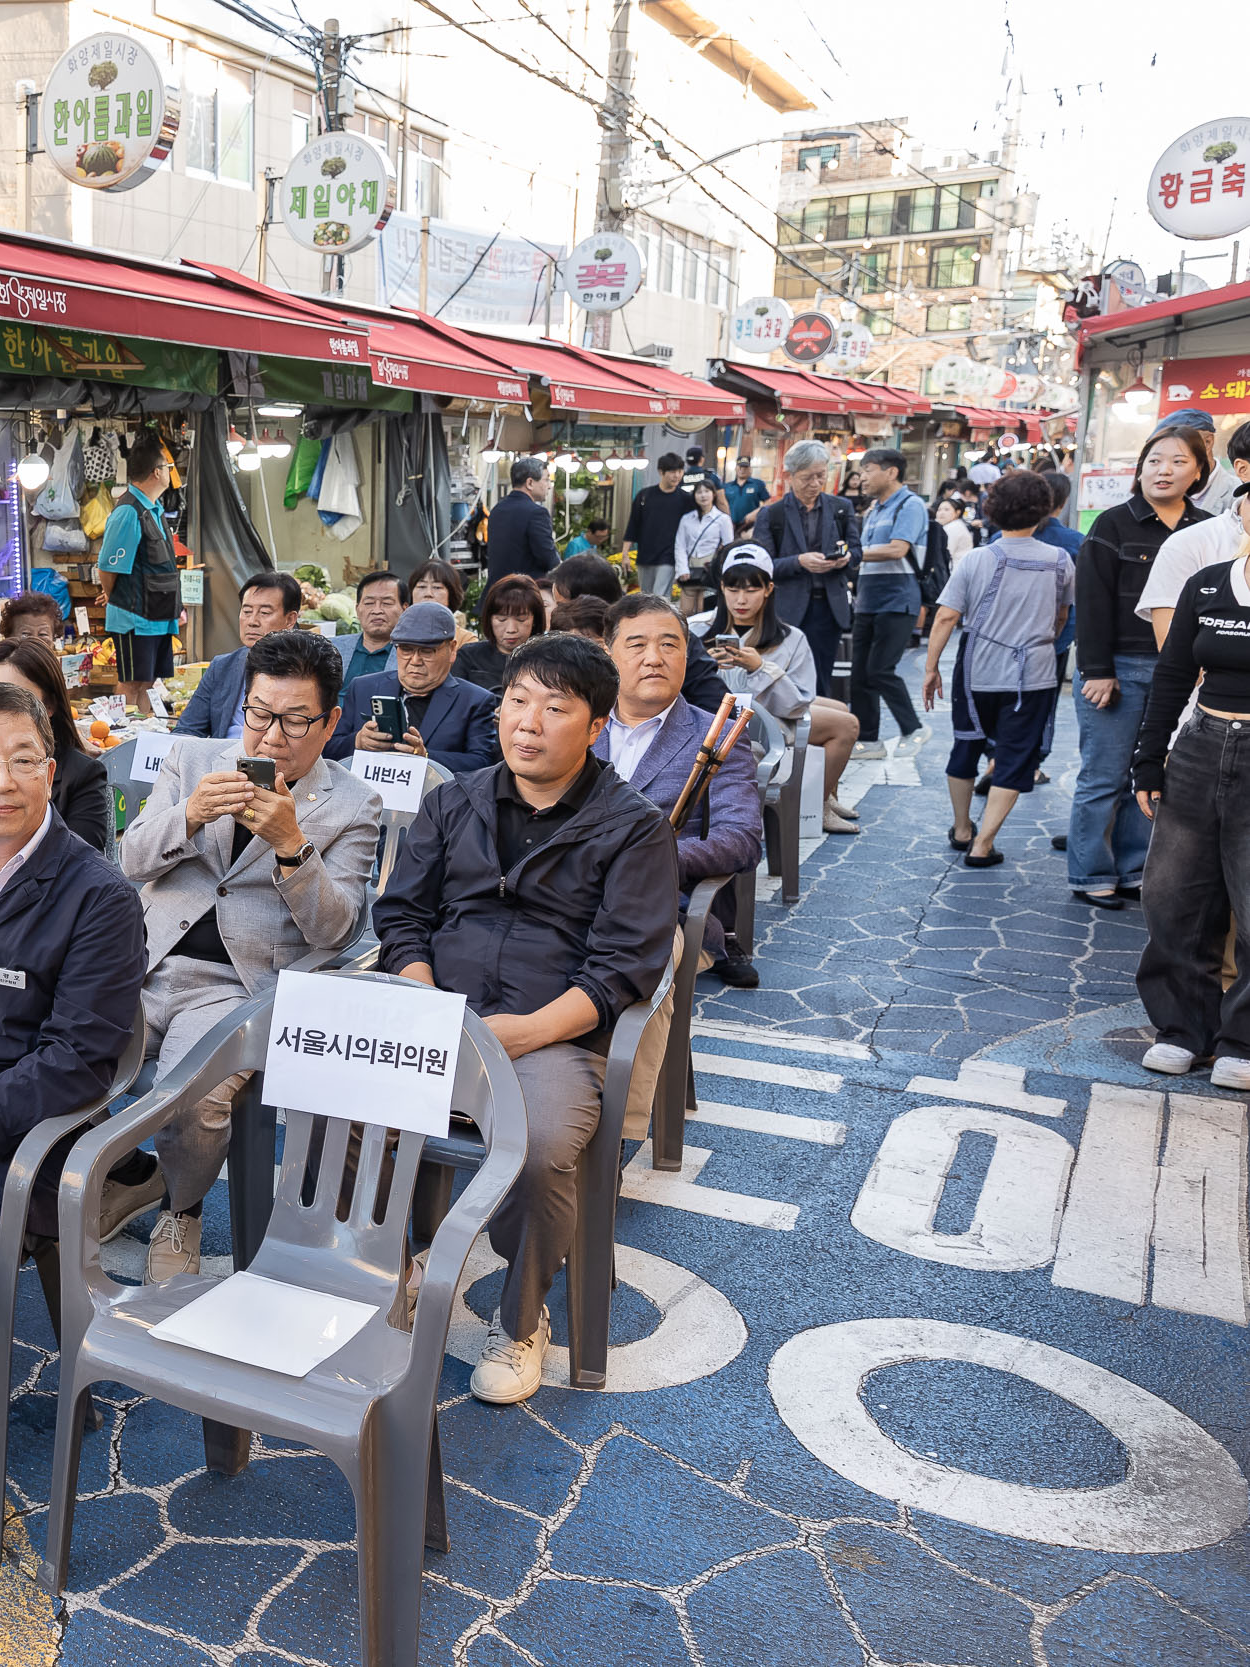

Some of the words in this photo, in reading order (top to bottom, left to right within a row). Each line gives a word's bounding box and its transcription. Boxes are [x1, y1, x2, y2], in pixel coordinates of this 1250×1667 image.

[67, 41, 138, 73] 화양제일시장
[53, 89, 154, 146] 한아름과일
[303, 141, 365, 165] 화양제일시장
[1180, 125, 1250, 153] 화양제일시
[289, 179, 379, 219] 제일야채
[583, 291, 620, 303] 한아름
[364, 765, 411, 785] 내빈석
[276, 1026, 448, 1076] 서울시의회의원
